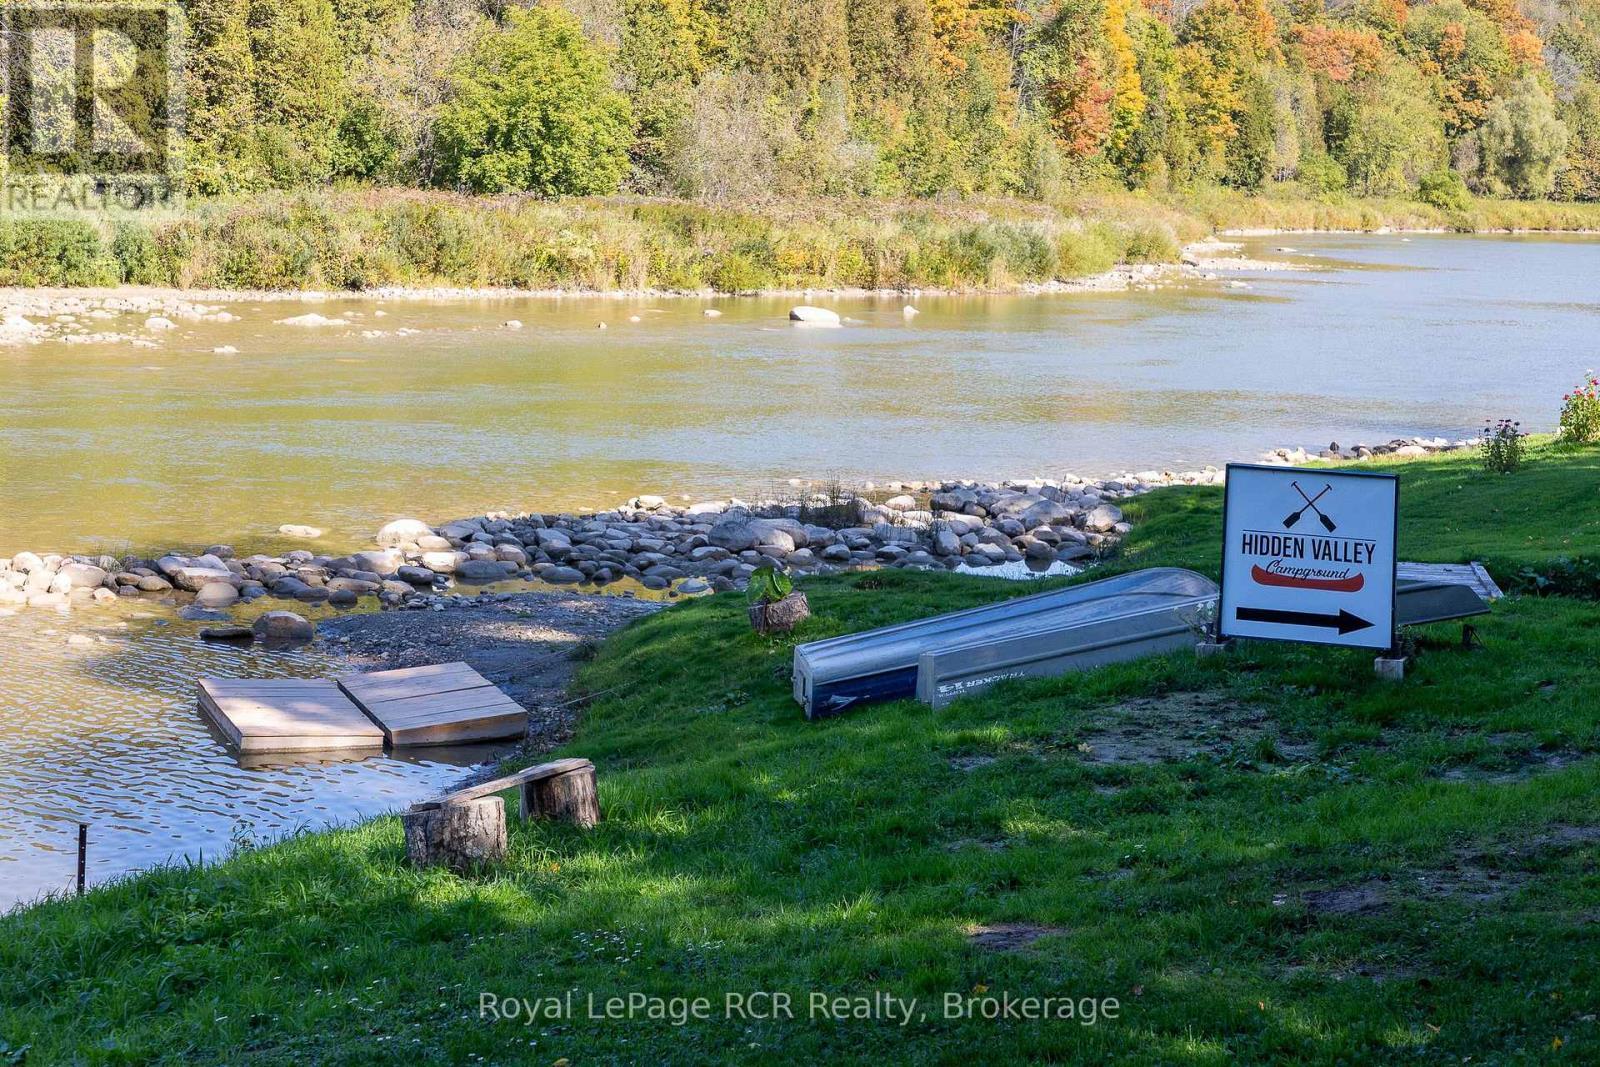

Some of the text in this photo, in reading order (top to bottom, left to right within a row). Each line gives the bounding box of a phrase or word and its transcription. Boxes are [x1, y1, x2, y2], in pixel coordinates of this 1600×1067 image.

[1241, 533, 1376, 564] HIDDEN VALLEY
[1265, 558, 1351, 580] Campground
[966, 671, 1025, 687] TRACKER
